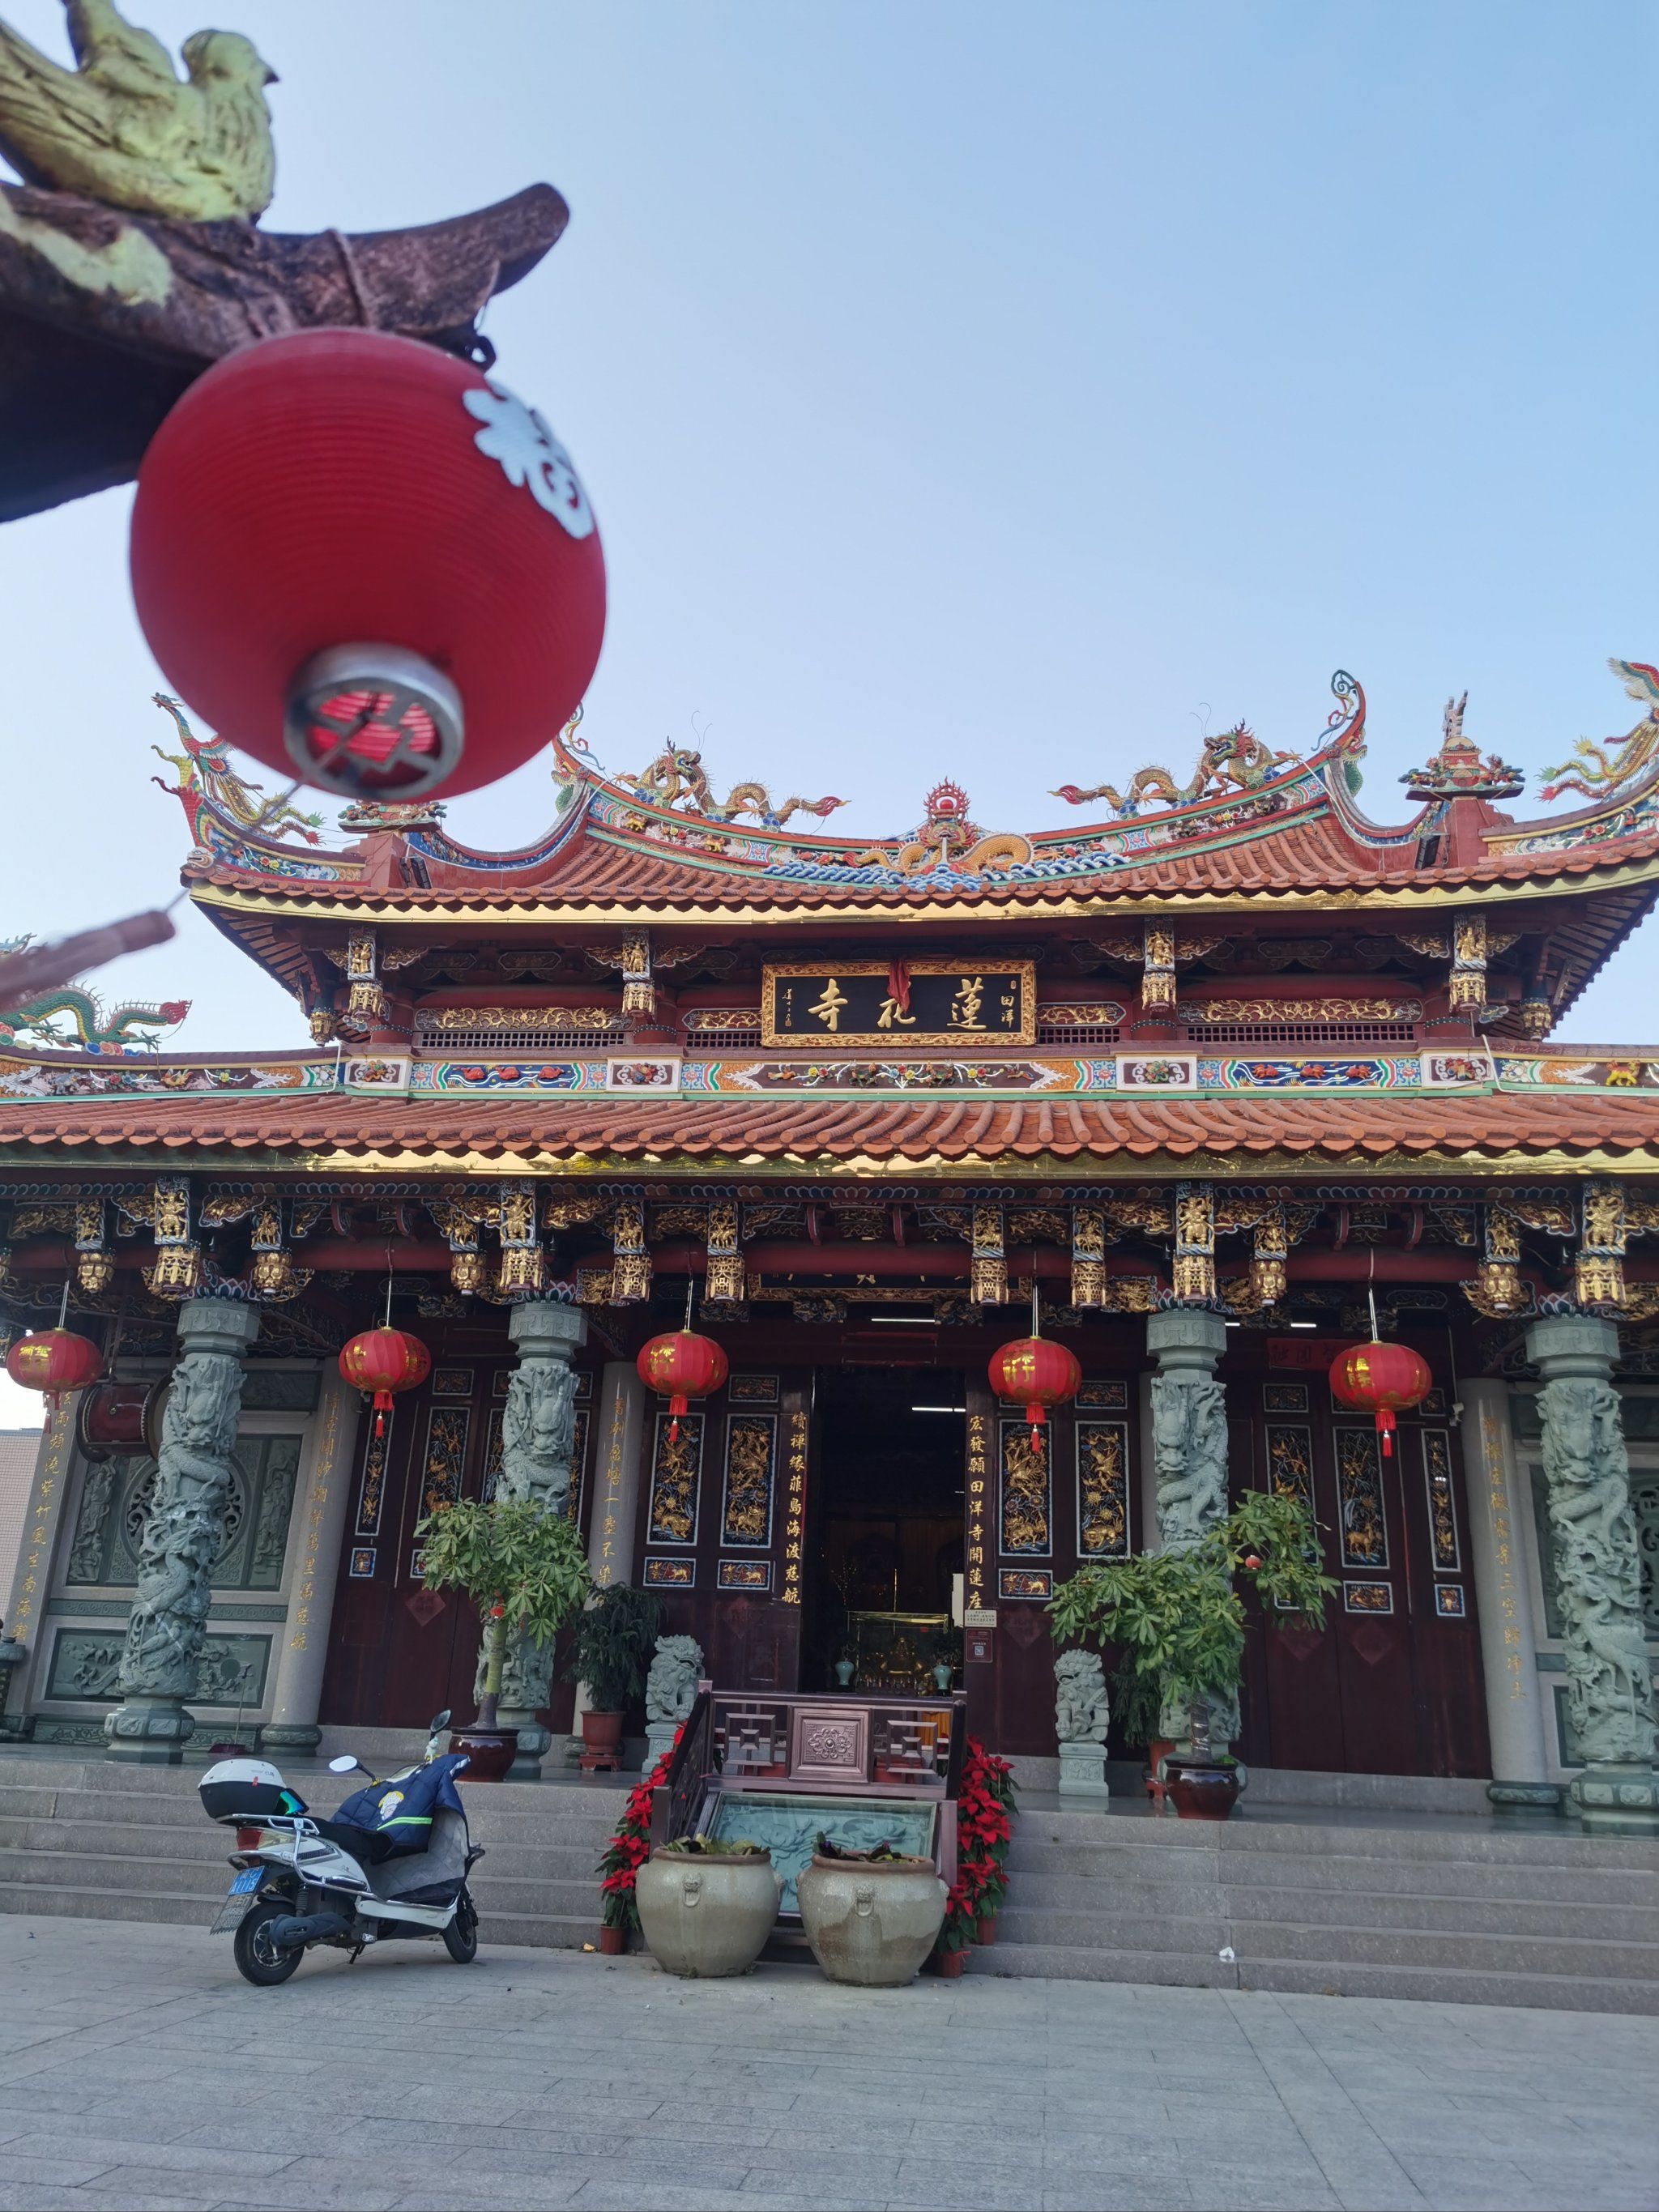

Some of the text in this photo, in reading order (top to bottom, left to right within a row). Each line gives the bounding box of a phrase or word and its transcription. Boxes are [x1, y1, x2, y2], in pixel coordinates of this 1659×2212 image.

[1001, 995, 1014, 1029] 田洋
[967, 1415, 986, 1610] 宏發願田洋寺開蓮座
